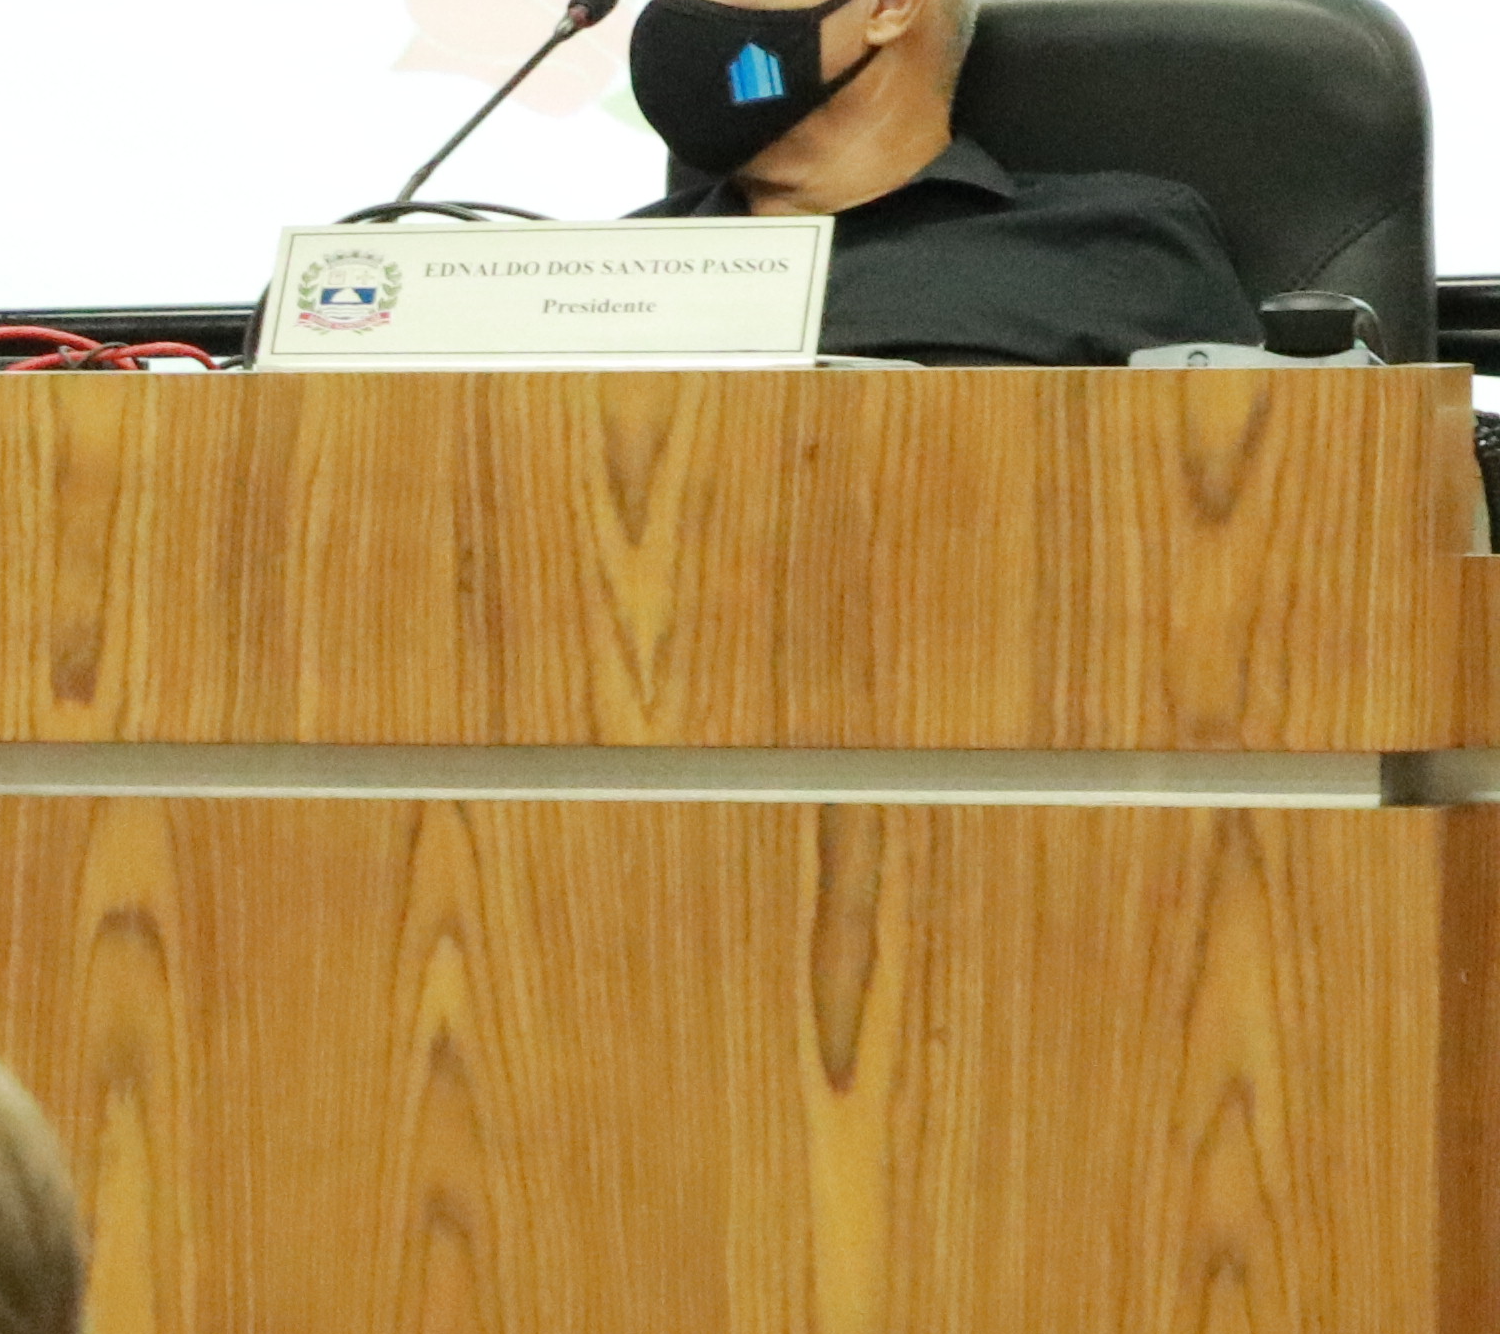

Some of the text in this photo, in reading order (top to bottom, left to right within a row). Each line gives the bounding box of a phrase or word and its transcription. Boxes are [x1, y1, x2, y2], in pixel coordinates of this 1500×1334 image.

[424, 258, 791, 277] EDNALDO DOS SANTOS PASSOS
[541, 298, 658, 314] Presidente
